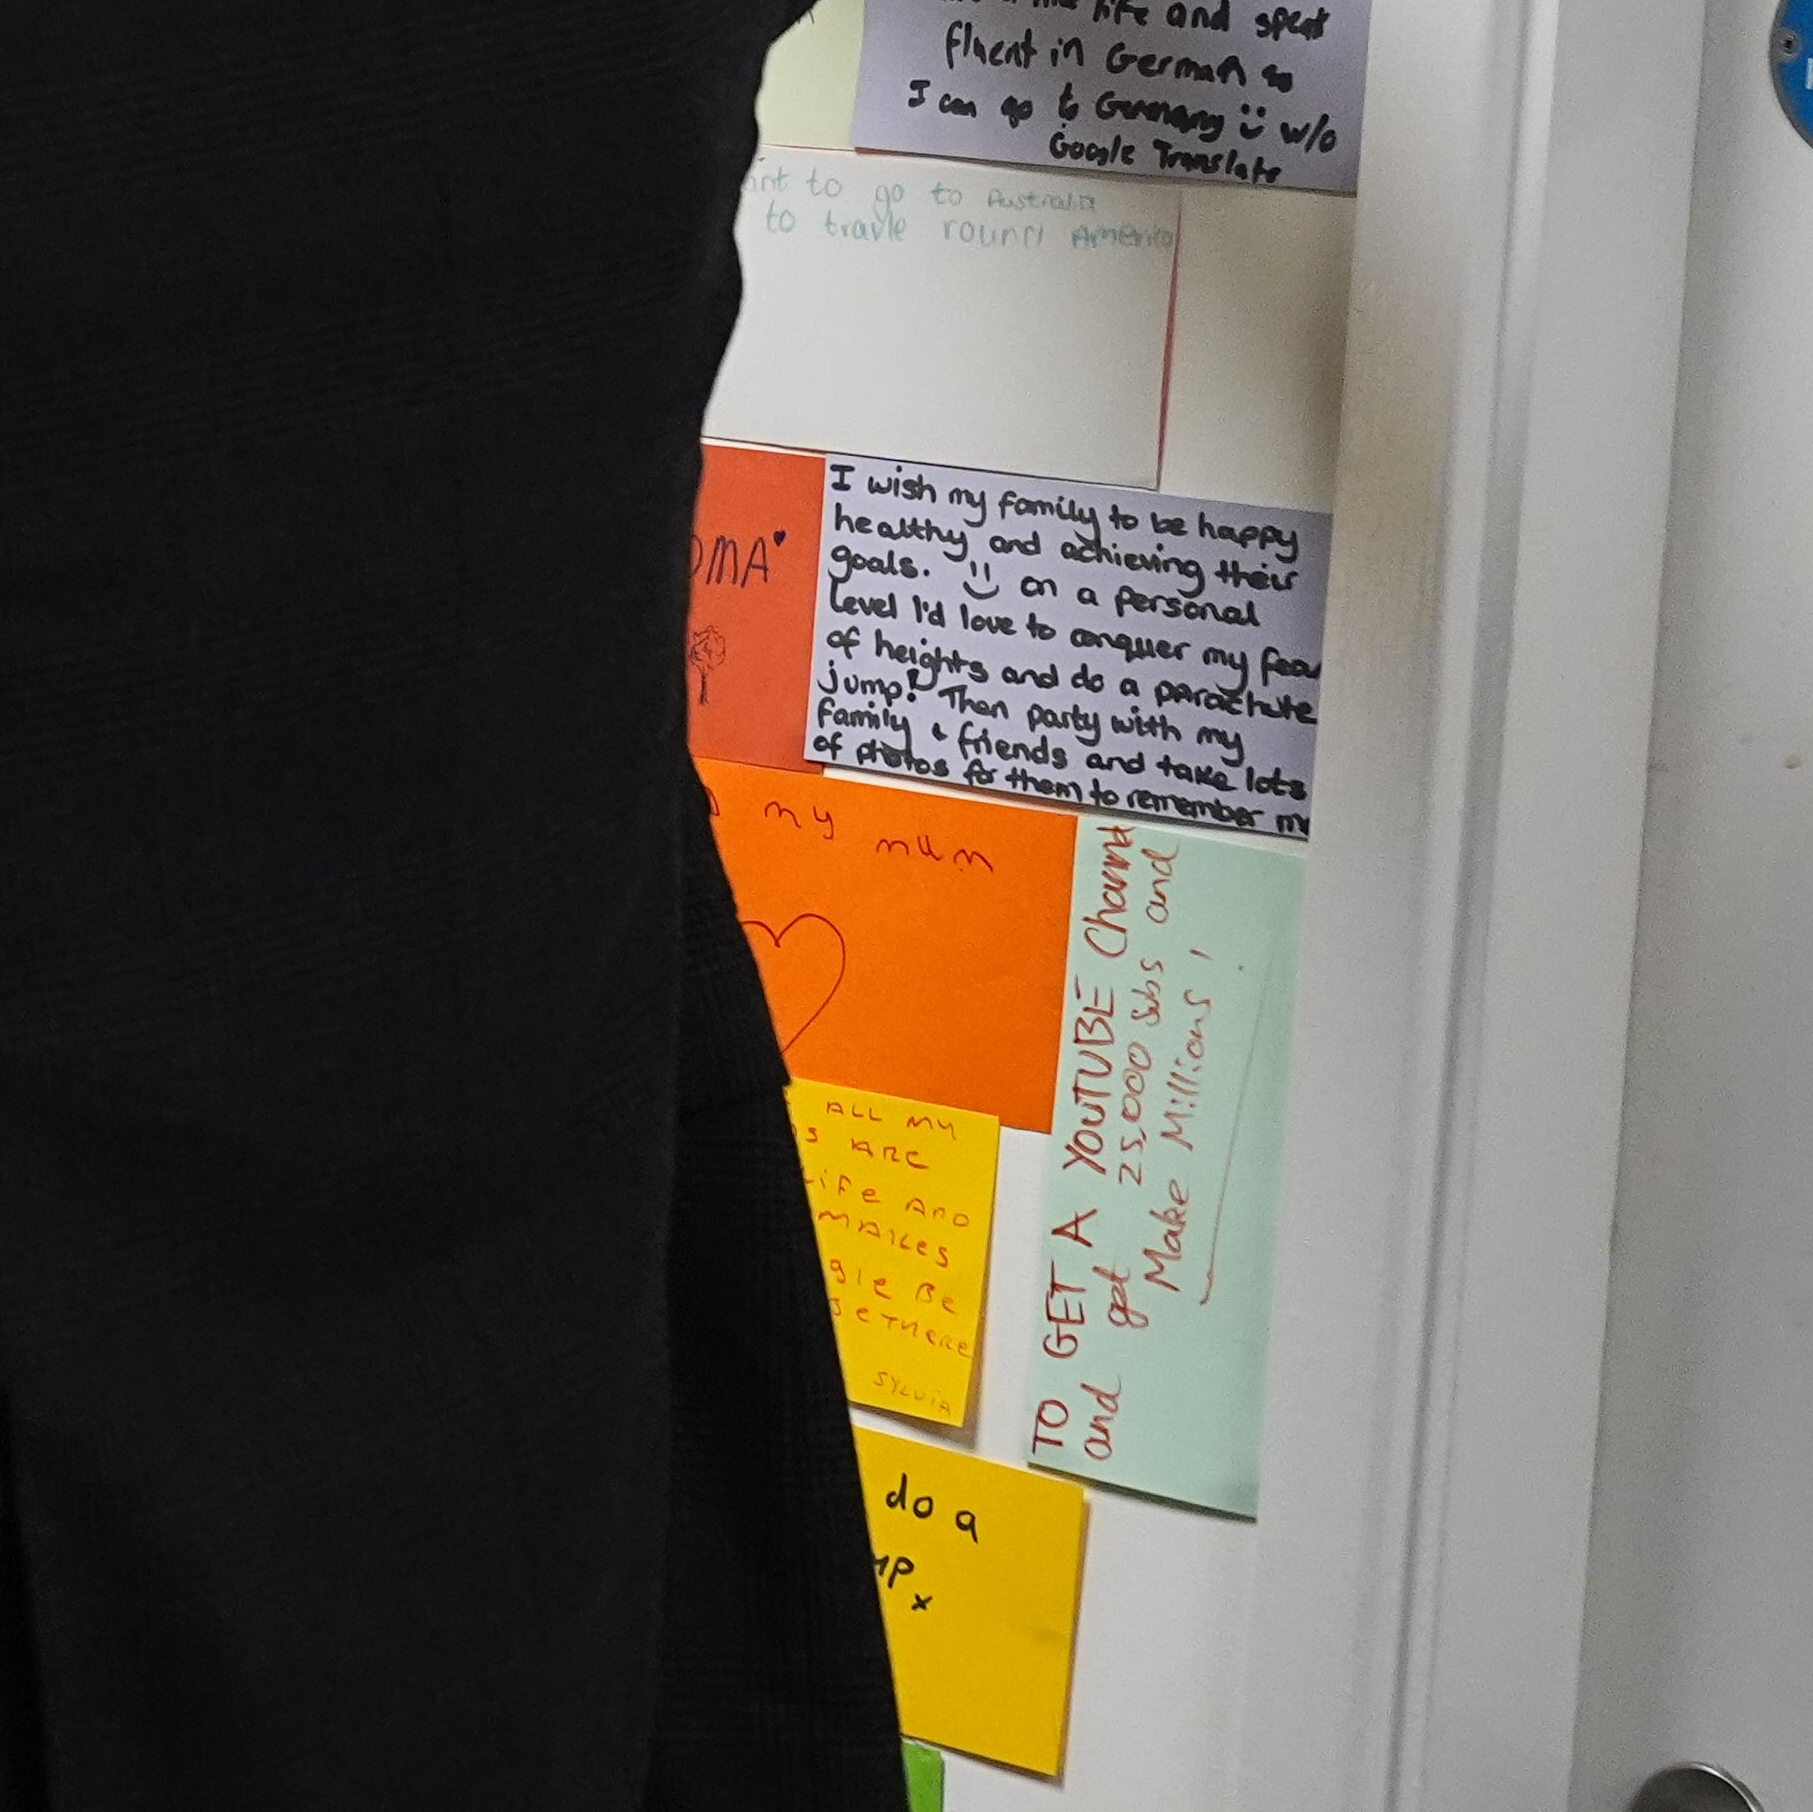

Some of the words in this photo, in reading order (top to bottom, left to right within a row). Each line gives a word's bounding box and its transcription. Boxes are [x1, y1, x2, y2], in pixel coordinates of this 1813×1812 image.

[1050, 37, 1084, 67] in
[1105, 41, 1247, 87] German
[908, 79, 931, 108] I
[939, 92, 977, 119] can
[1001, 95, 1033, 129] go
[806, 166, 843, 199] to
[875, 182, 906, 212] go
[930, 180, 963, 206] to
[1049, 131, 1135, 167] Google
[1153, 138, 1282, 184] Translate
[765, 200, 796, 233] to
[830, 463, 856, 492] I
[867, 466, 936, 503] wish
[948, 487, 987, 527] my
[998, 490, 1100, 544] family
[1108, 503, 1139, 530] to
[1151, 513, 1186, 537] be
[1199, 514, 1299, 565] happy
[827, 544, 930, 582] goals.
[1076, 586, 1099, 606] a
[1115, 588, 1260, 627] personal
[834, 503, 968, 562] healthy
[989, 531, 1042, 556] and
[1061, 532, 1205, 599] achieving
[1215, 561, 1299, 591] their
[826, 626, 860, 659] of
[875, 631, 988, 692] heights
[1001, 664, 1059, 689] and
[1071, 665, 1104, 693] do
[1119, 678, 1140, 697] a
[829, 574, 897, 618] level
[960, 604, 1014, 635] love
[1026, 613, 1057, 640] to
[1069, 631, 1191, 662] conquer
[1203, 646, 1250, 690] my
[817, 698, 911, 750] family
[957, 725, 1069, 771] friends
[1086, 745, 1146, 776] and
[1157, 755, 1229, 792] take
[938, 684, 1009, 721] Then
[1026, 702, 1101, 746] party
[1111, 706, 1182, 742] with
[1196, 727, 1245, 767] my
[813, 733, 844, 762] of
[856, 737, 950, 778] photos
[962, 760, 1000, 788] for
[1004, 765, 1083, 800] them
[1089, 778, 1119, 808] to
[1126, 790, 1263, 828] remember
[764, 799, 834, 840] my
[1140, 840, 1179, 924] and
[1131, 958, 1164, 1027] subs
[826, 1100, 883, 1122] ALL
[1051, 1207, 1098, 1249] A
[1143, 1177, 1190, 1293] Make
[1042, 1275, 1089, 1360] GET
[1093, 1264, 1149, 1330] get
[1032, 1397, 1069, 1455] TO
[1083, 1373, 1122, 1461] and
[886, 1472, 934, 1519] do
[955, 1510, 979, 1545] a
